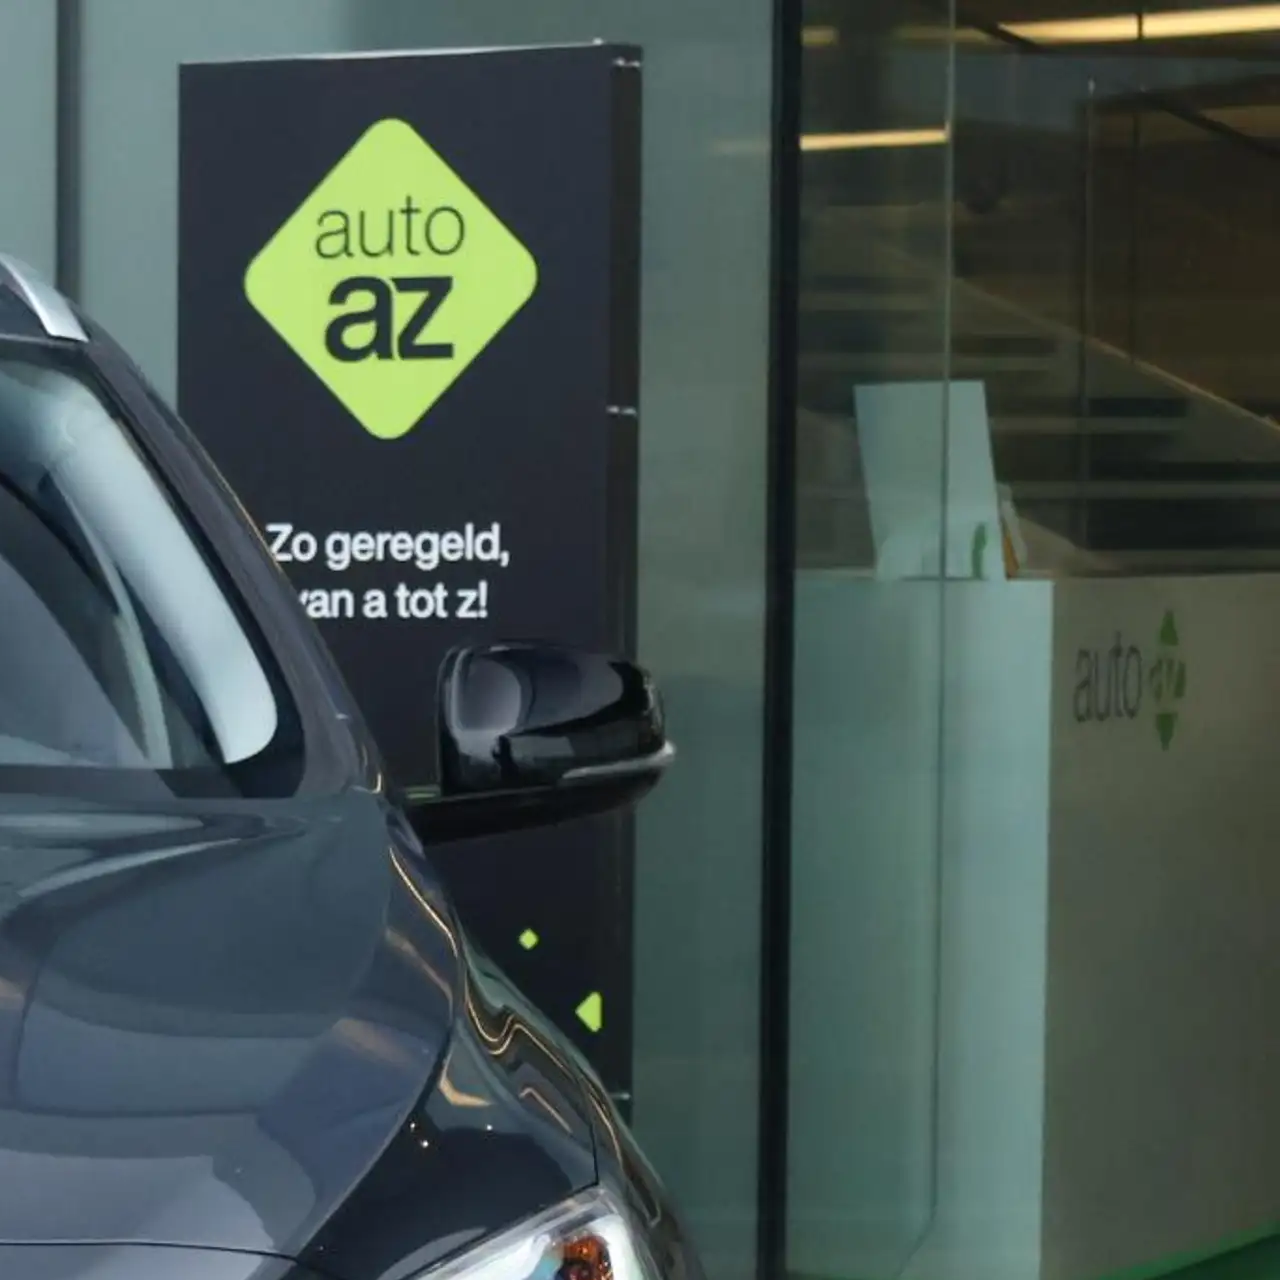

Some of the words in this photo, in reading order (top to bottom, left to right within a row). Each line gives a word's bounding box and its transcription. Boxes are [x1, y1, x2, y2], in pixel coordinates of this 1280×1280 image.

[315, 194, 466, 259] auto
[324, 275, 455, 364] az
[266, 523, 318, 562] Zo
[324, 521, 510, 571] geregeld,
[362, 588, 389, 618] a
[394, 581, 449, 618] tot
[455, 579, 488, 619] z!
[1073, 630, 1142, 723] auto
